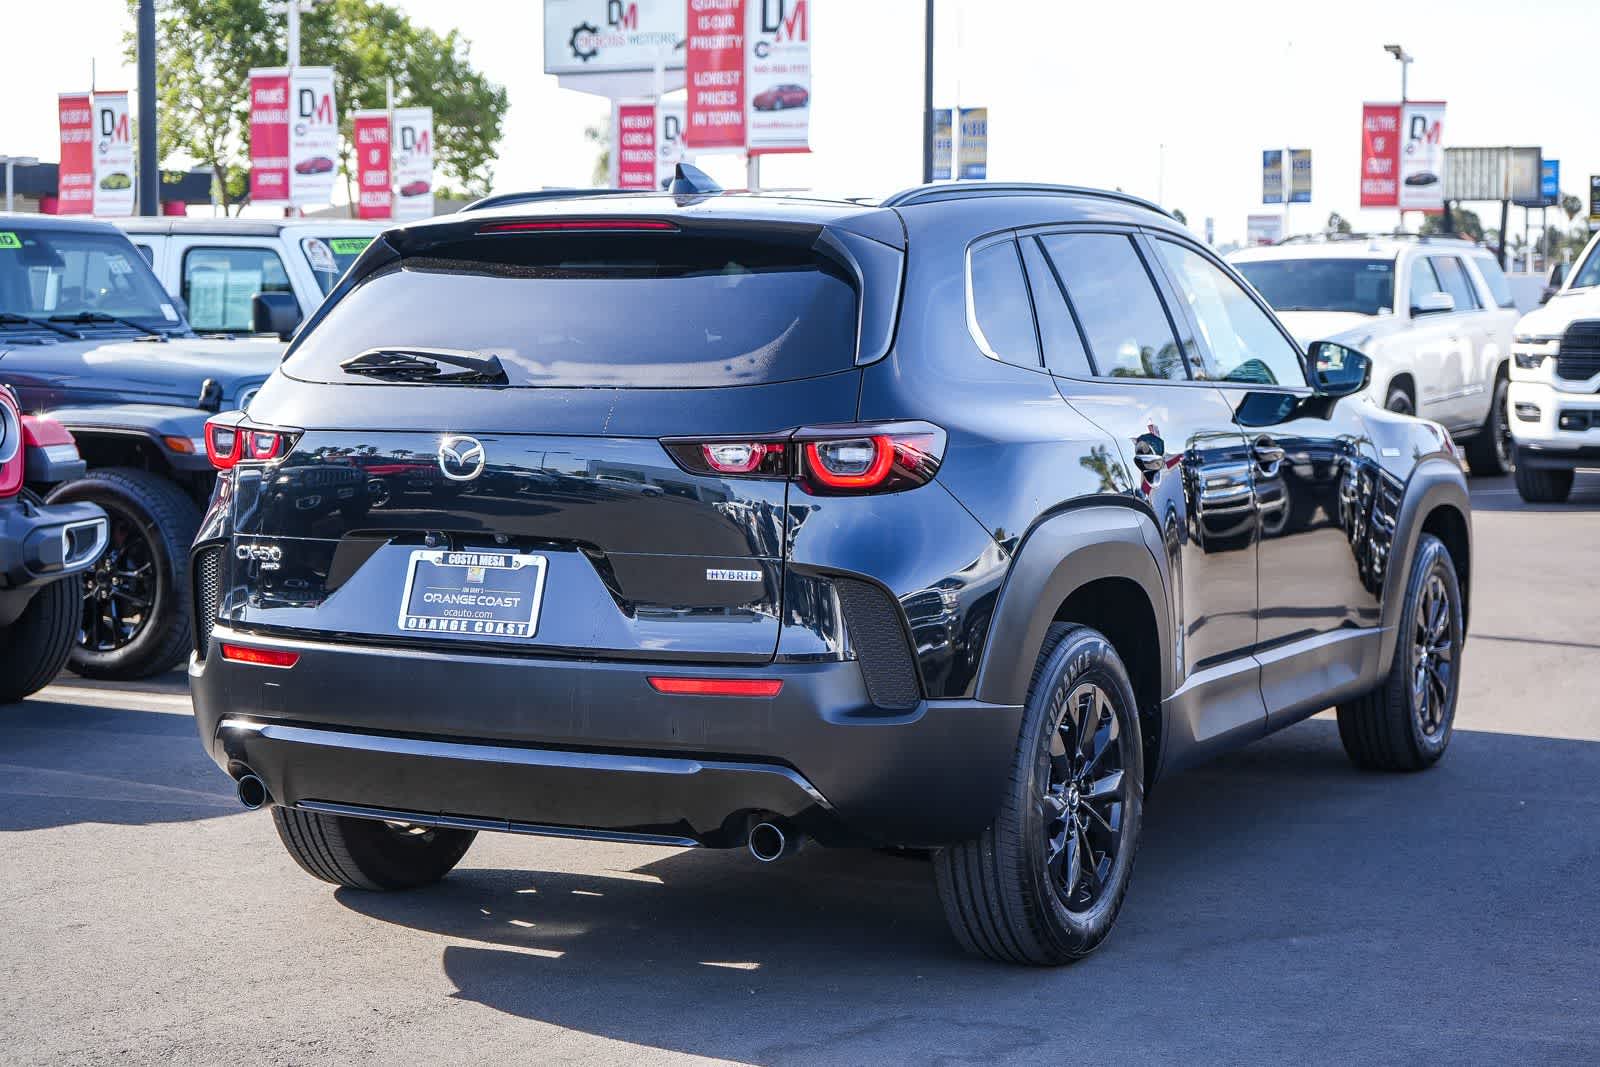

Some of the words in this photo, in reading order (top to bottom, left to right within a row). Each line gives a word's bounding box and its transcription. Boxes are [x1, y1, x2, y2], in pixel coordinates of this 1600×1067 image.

[690, 36, 743, 49] PRIORITY
[694, 71, 740, 86] LOWEST
[697, 91, 737, 105] PRICES
[708, 112, 742, 126] TOWN
[236, 544, 281, 561] CX-50
[448, 554, 478, 566] COSTA
[479, 555, 505, 567] MESA
[711, 570, 759, 580] HYBRID
[423, 592, 476, 605] ORANGE
[477, 595, 521, 608] COAST
[443, 608, 493, 619] ocauto.com
[408, 617, 468, 632] ORANGE
[474, 620, 528, 635] COAST
